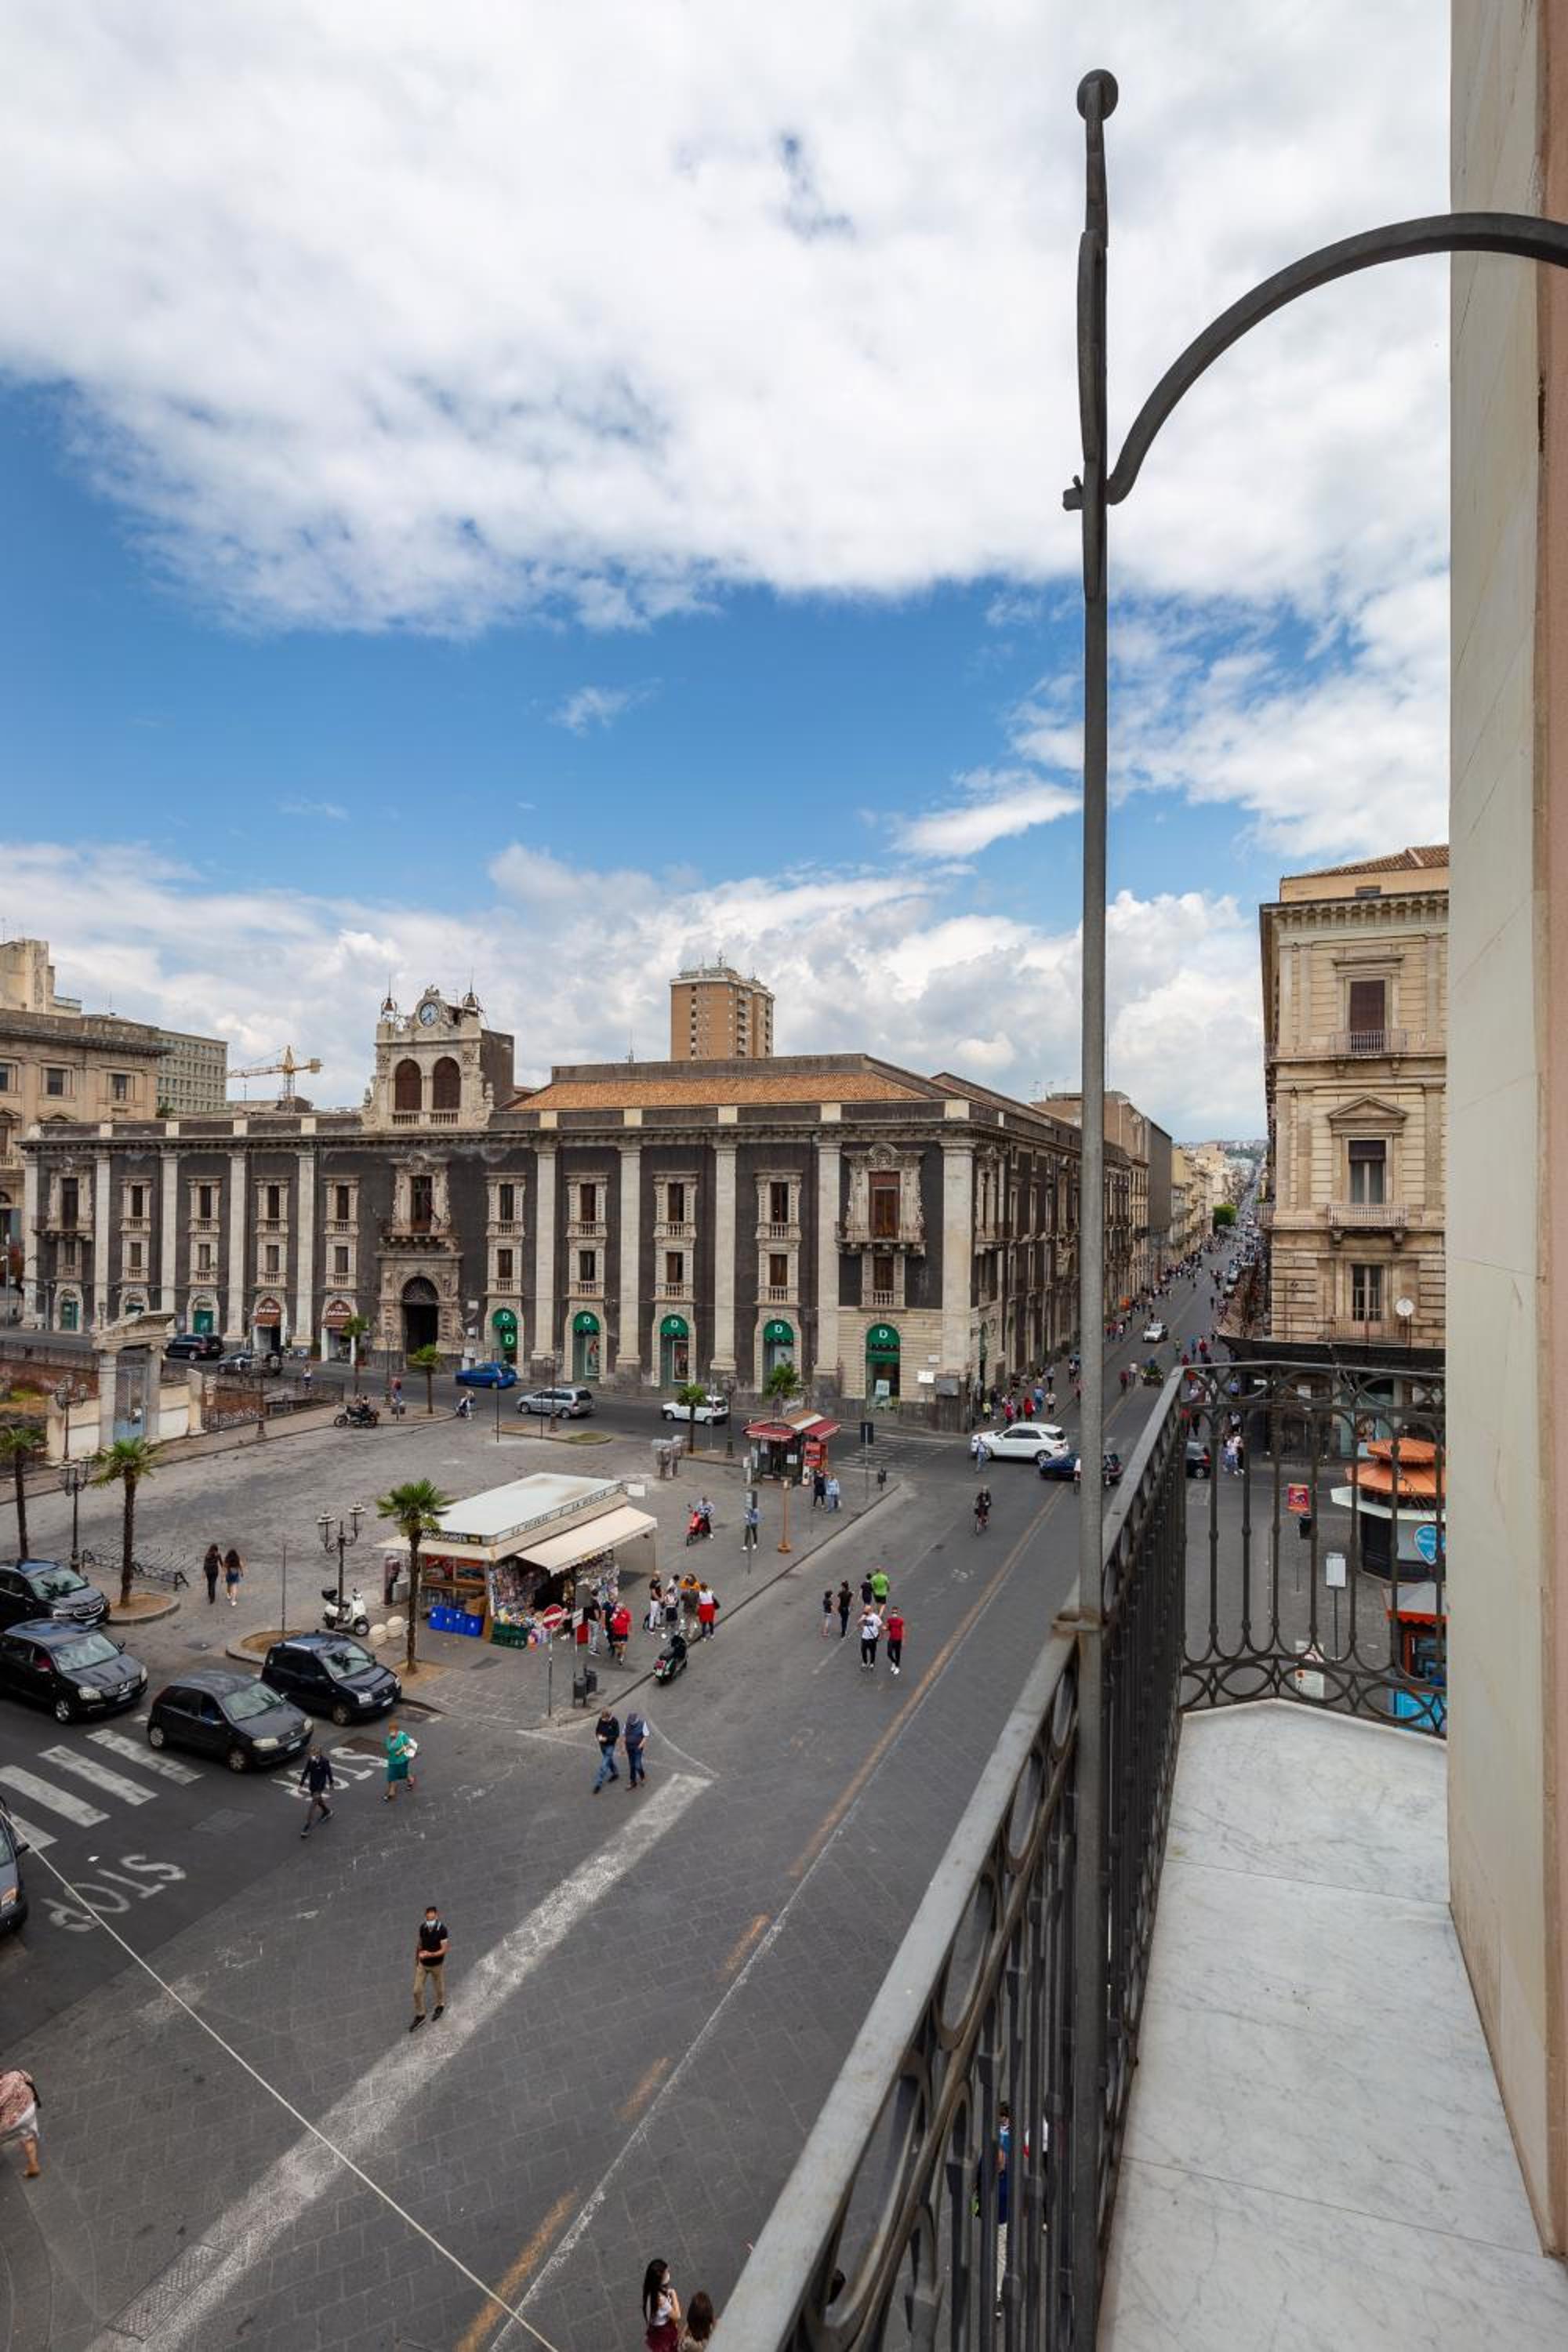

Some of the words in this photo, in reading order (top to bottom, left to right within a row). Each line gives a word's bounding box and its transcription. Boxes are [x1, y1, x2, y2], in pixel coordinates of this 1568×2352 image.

[775, 1325, 783, 1334] D
[879, 1330, 888, 1338] D
[506, 1334, 514, 1344] D
[41, 1854, 187, 1933] STOP
